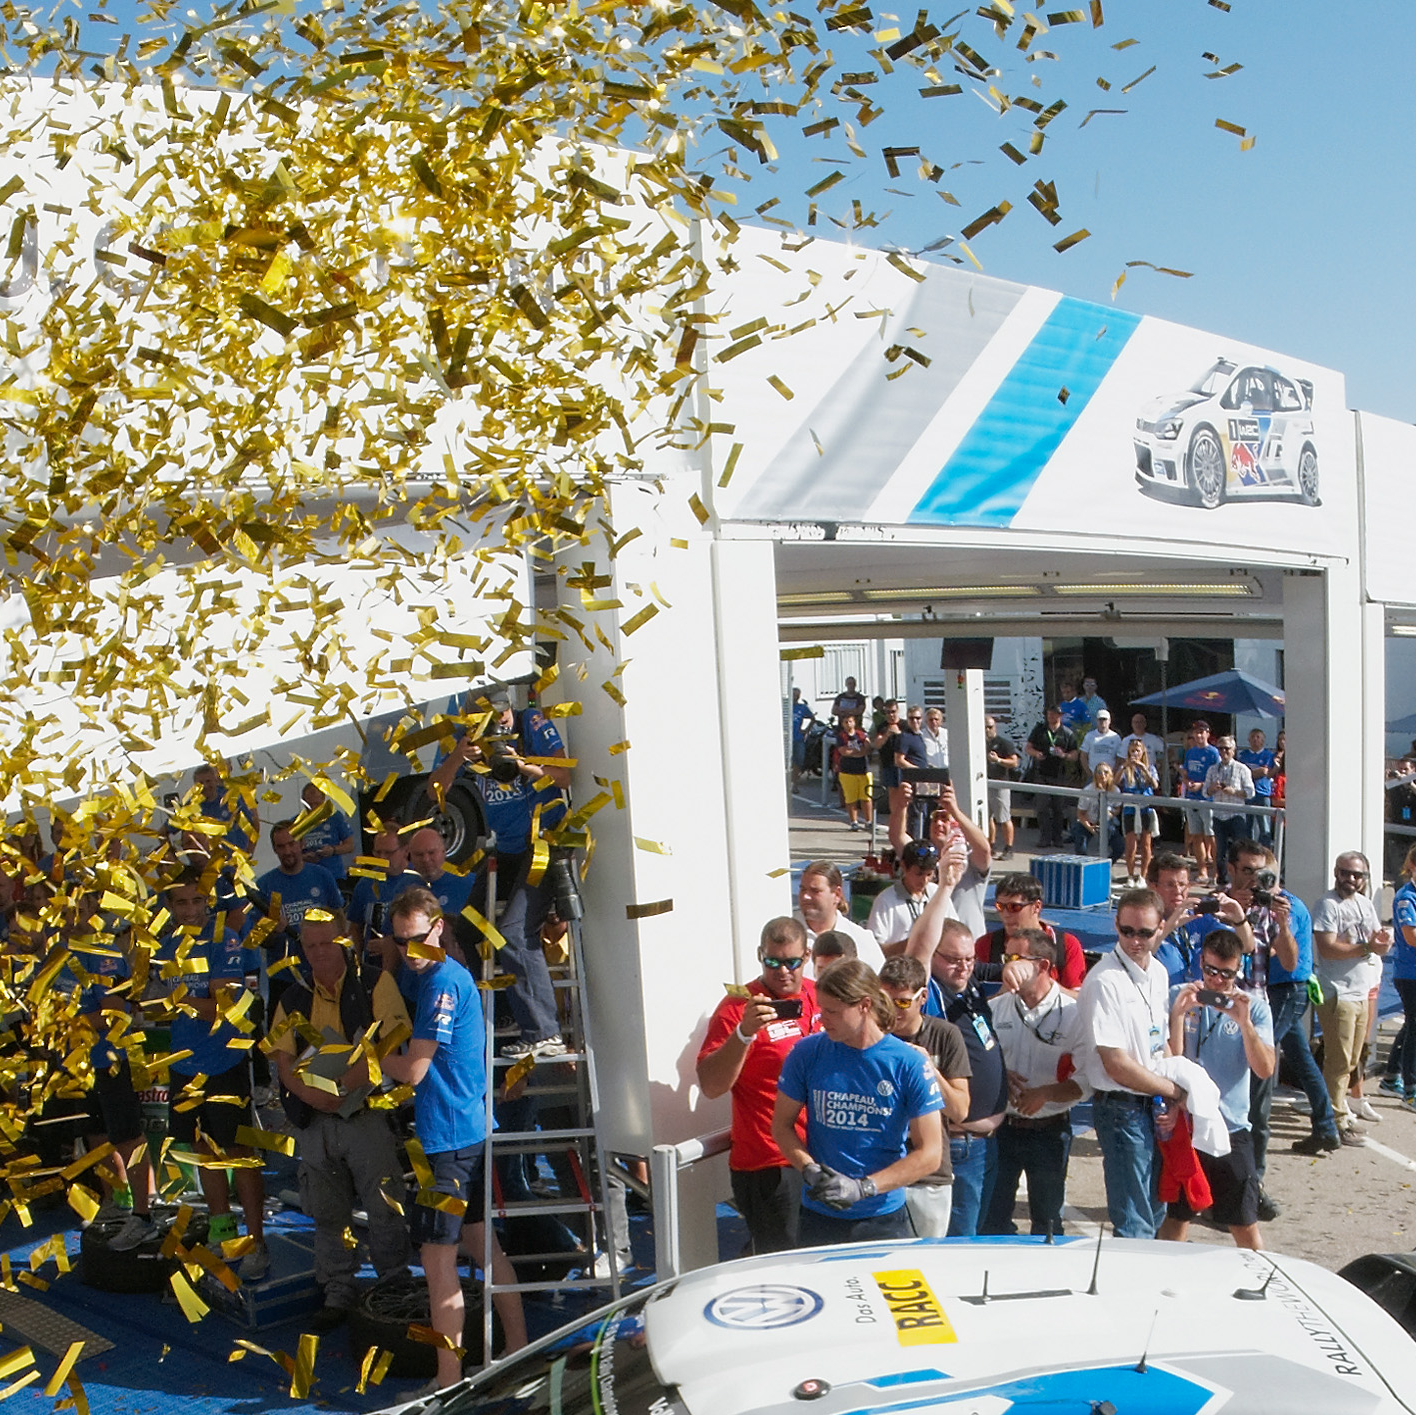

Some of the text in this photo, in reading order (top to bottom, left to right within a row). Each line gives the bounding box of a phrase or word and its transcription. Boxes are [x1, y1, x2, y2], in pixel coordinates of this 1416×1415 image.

[138, 1087, 168, 1102] astro
[825, 1109, 869, 1127] 2014
[855, 1305, 877, 1324] Das
[877, 1279, 945, 1332] RACC
